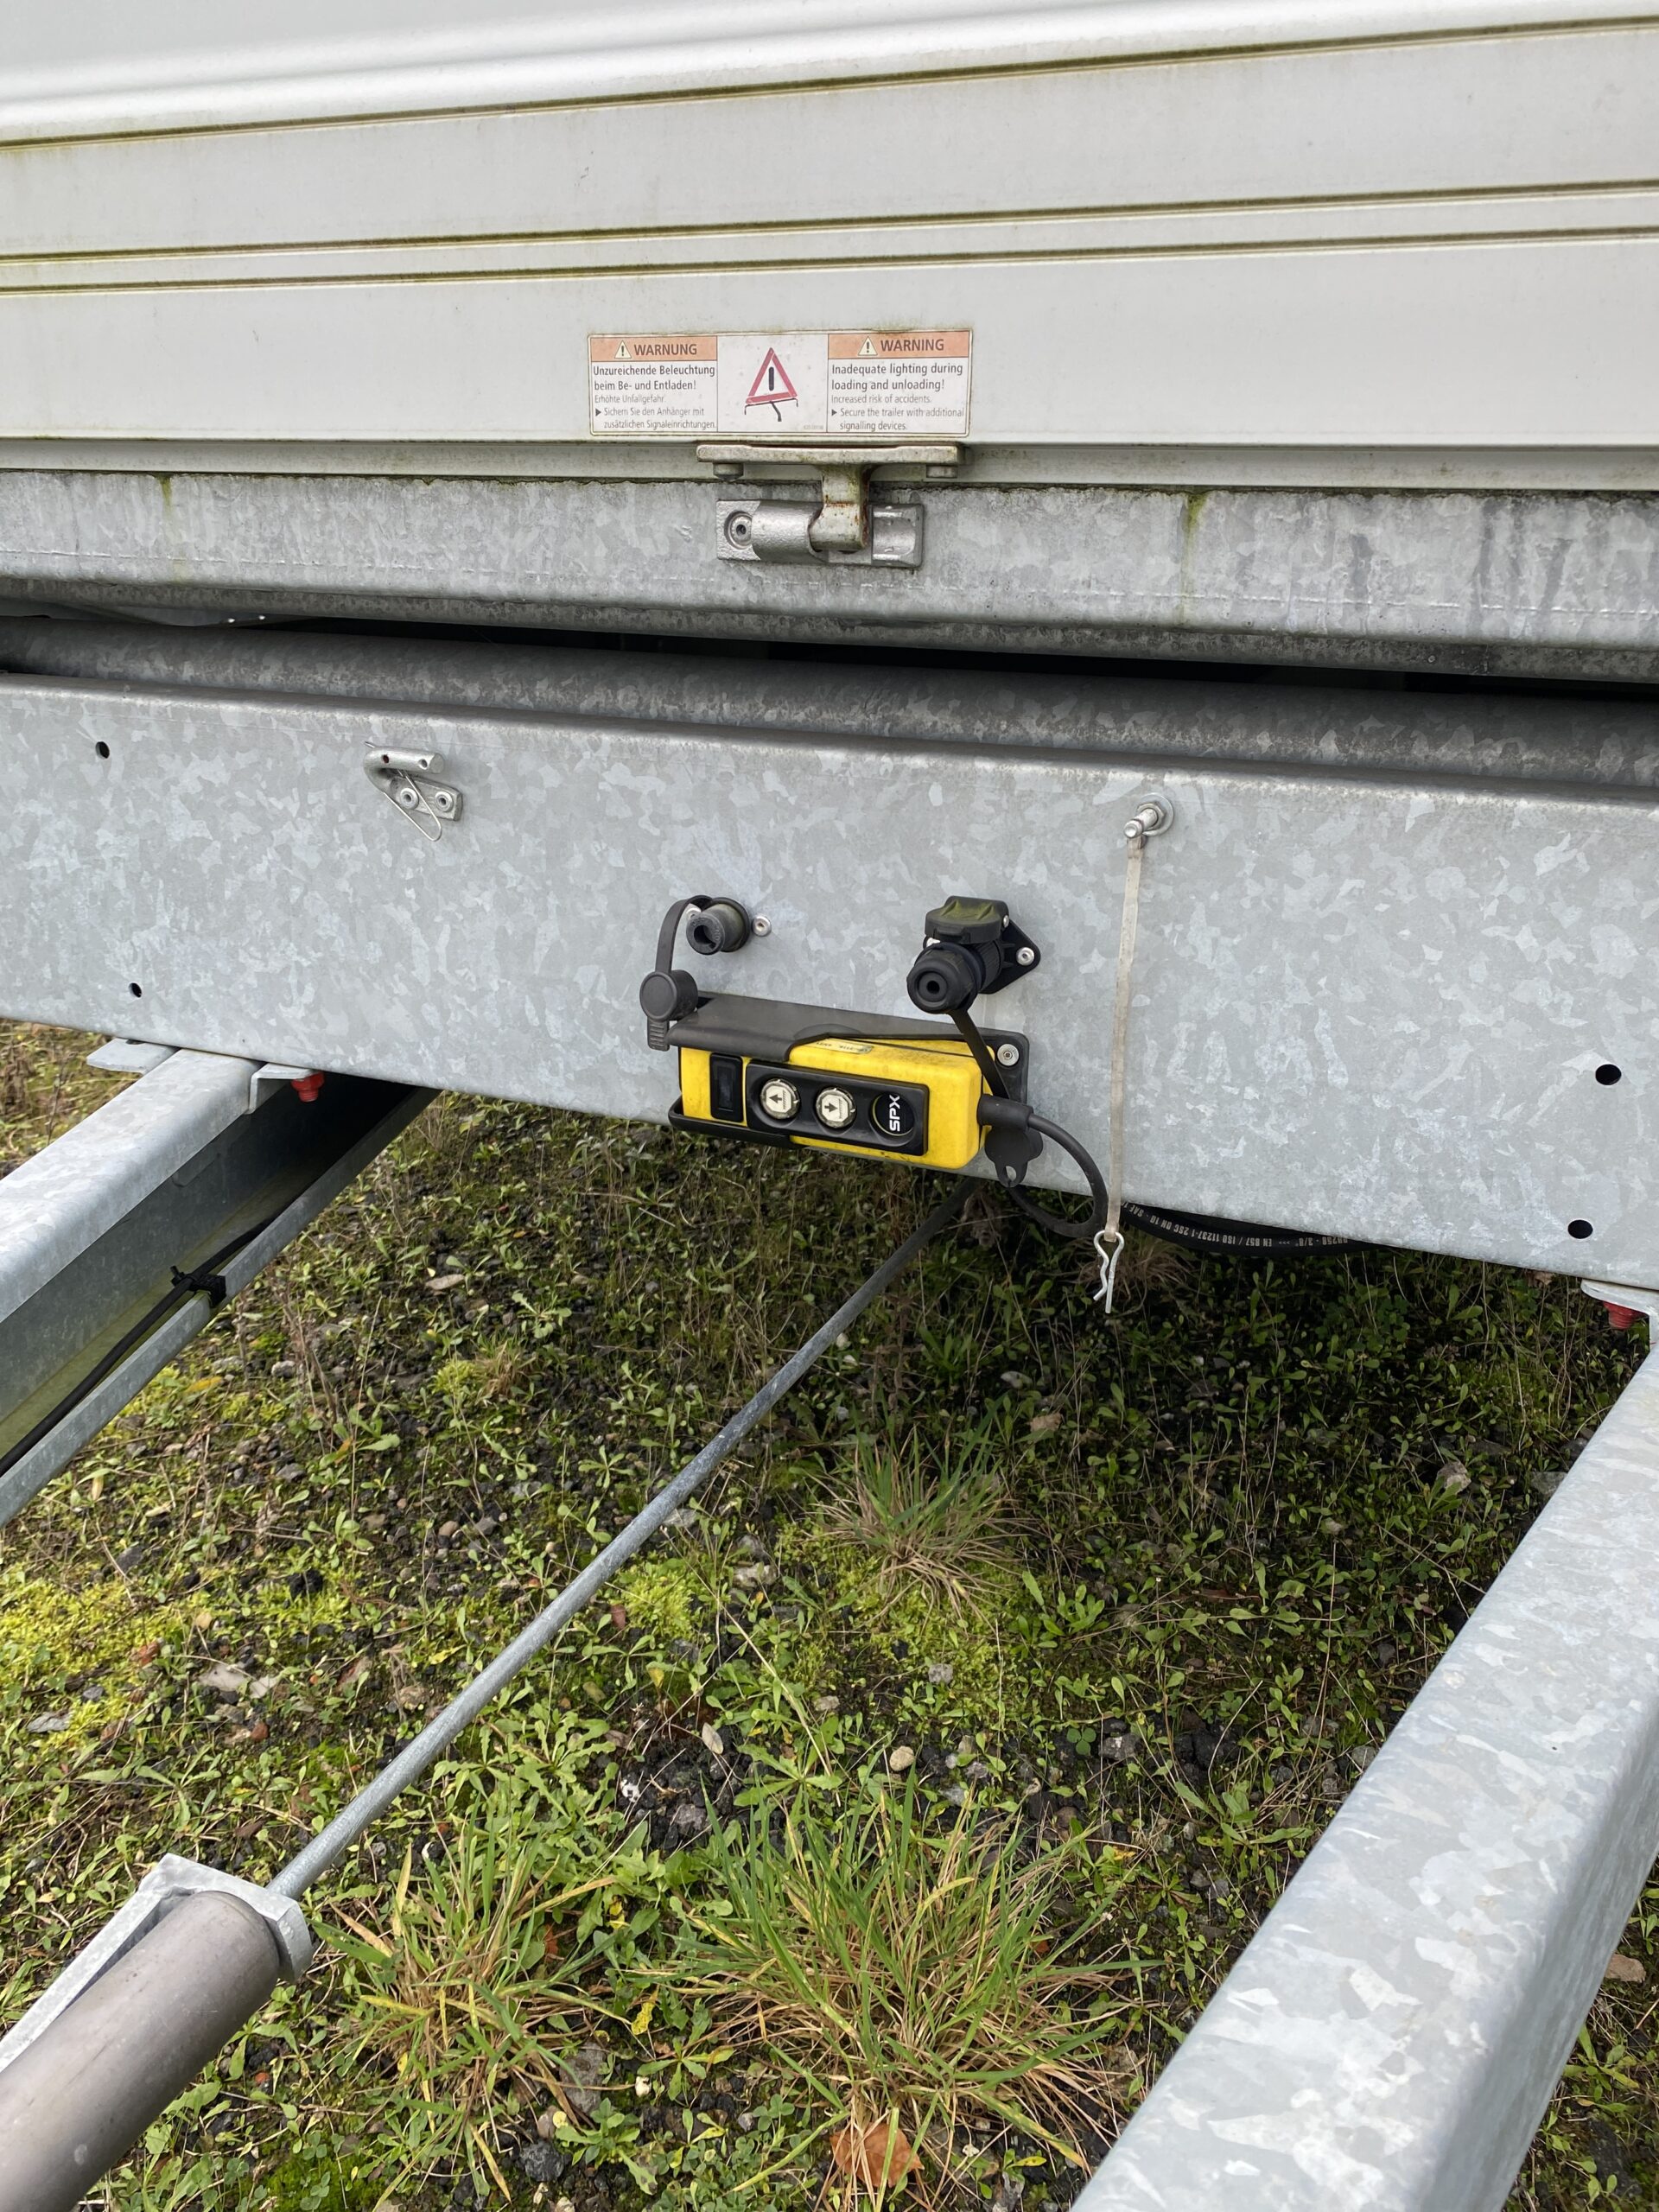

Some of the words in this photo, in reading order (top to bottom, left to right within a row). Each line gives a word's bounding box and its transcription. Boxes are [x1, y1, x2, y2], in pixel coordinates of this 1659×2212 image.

[634, 344, 697, 355] WARNUNG
[880, 339, 944, 351] WARNING
[594, 365, 656, 376] Unzureichende
[660, 365, 715, 377] Beleuchtung
[832, 364, 886, 376] Inadequate
[890, 363, 926, 375] lighting
[931, 363, 963, 375] during
[594, 381, 614, 390] beim
[619, 381, 632, 390] Be-
[635, 380, 651, 390] und
[654, 380, 696, 390] Entladen!
[832, 380, 867, 391] loading
[871, 380, 888, 390] and
[893, 379, 944, 391] unloading!
[594, 394, 620, 403] Erhöhte
[622, 394, 665, 404] Unfallgefahr.
[831, 395, 867, 404] Increased
[869, 395, 881, 404] risk
[885, 394, 893, 403] of
[894, 394, 931, 403] accidents.
[604, 407, 627, 416] Sichern
[631, 407, 639, 416] Sie
[642, 407, 654, 416] den
[658, 407, 690, 417] Anhänger
[841, 408, 865, 416] Secure
[868, 408, 880, 416] the
[882, 408, 904, 416] trailer
[906, 408, 923, 416] with
[926, 407, 963, 416] additional
[604, 420, 644, 429] zusätzlichen
[647, 420, 716, 429] Signaleinrichtungen.
[840, 421, 876, 432] signalling
[878, 421, 906, 430] devices.
[889, 1094, 900, 1132] SPX
[1128, 1205, 1144, 1217] SAE
[1150, 1215, 1160, 1225] 10
[1160, 1219, 1173, 1230] DN
[1173, 1224, 1189, 1236] 2SC
[1191, 1229, 1220, 1243] 11237-1
[1223, 1235, 1236, 1245] ISO
[1262, 1237, 1273, 1247] EN
